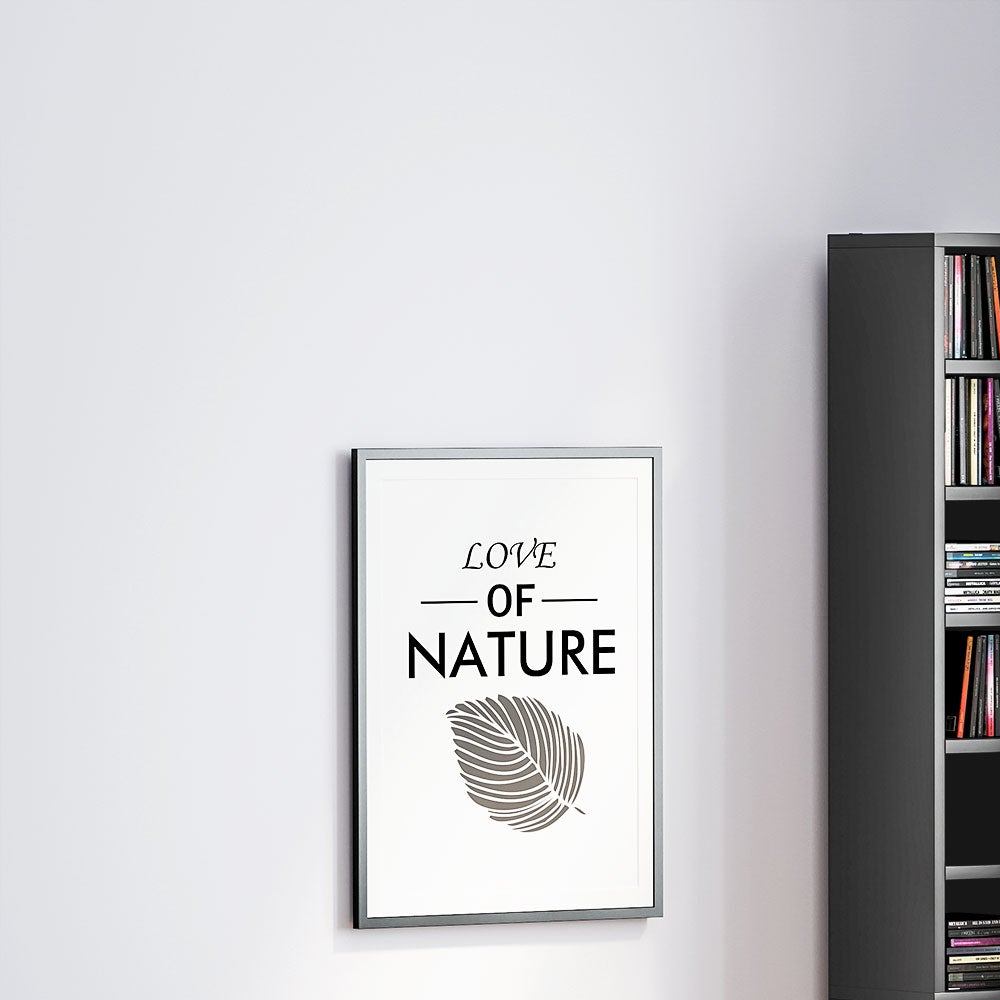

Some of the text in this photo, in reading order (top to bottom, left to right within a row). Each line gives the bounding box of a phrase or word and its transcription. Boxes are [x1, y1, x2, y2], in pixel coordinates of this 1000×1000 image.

[461, 537, 557, 570] LOVE
[487, 583, 536, 618] OF
[408, 628, 616, 679] NATURE
